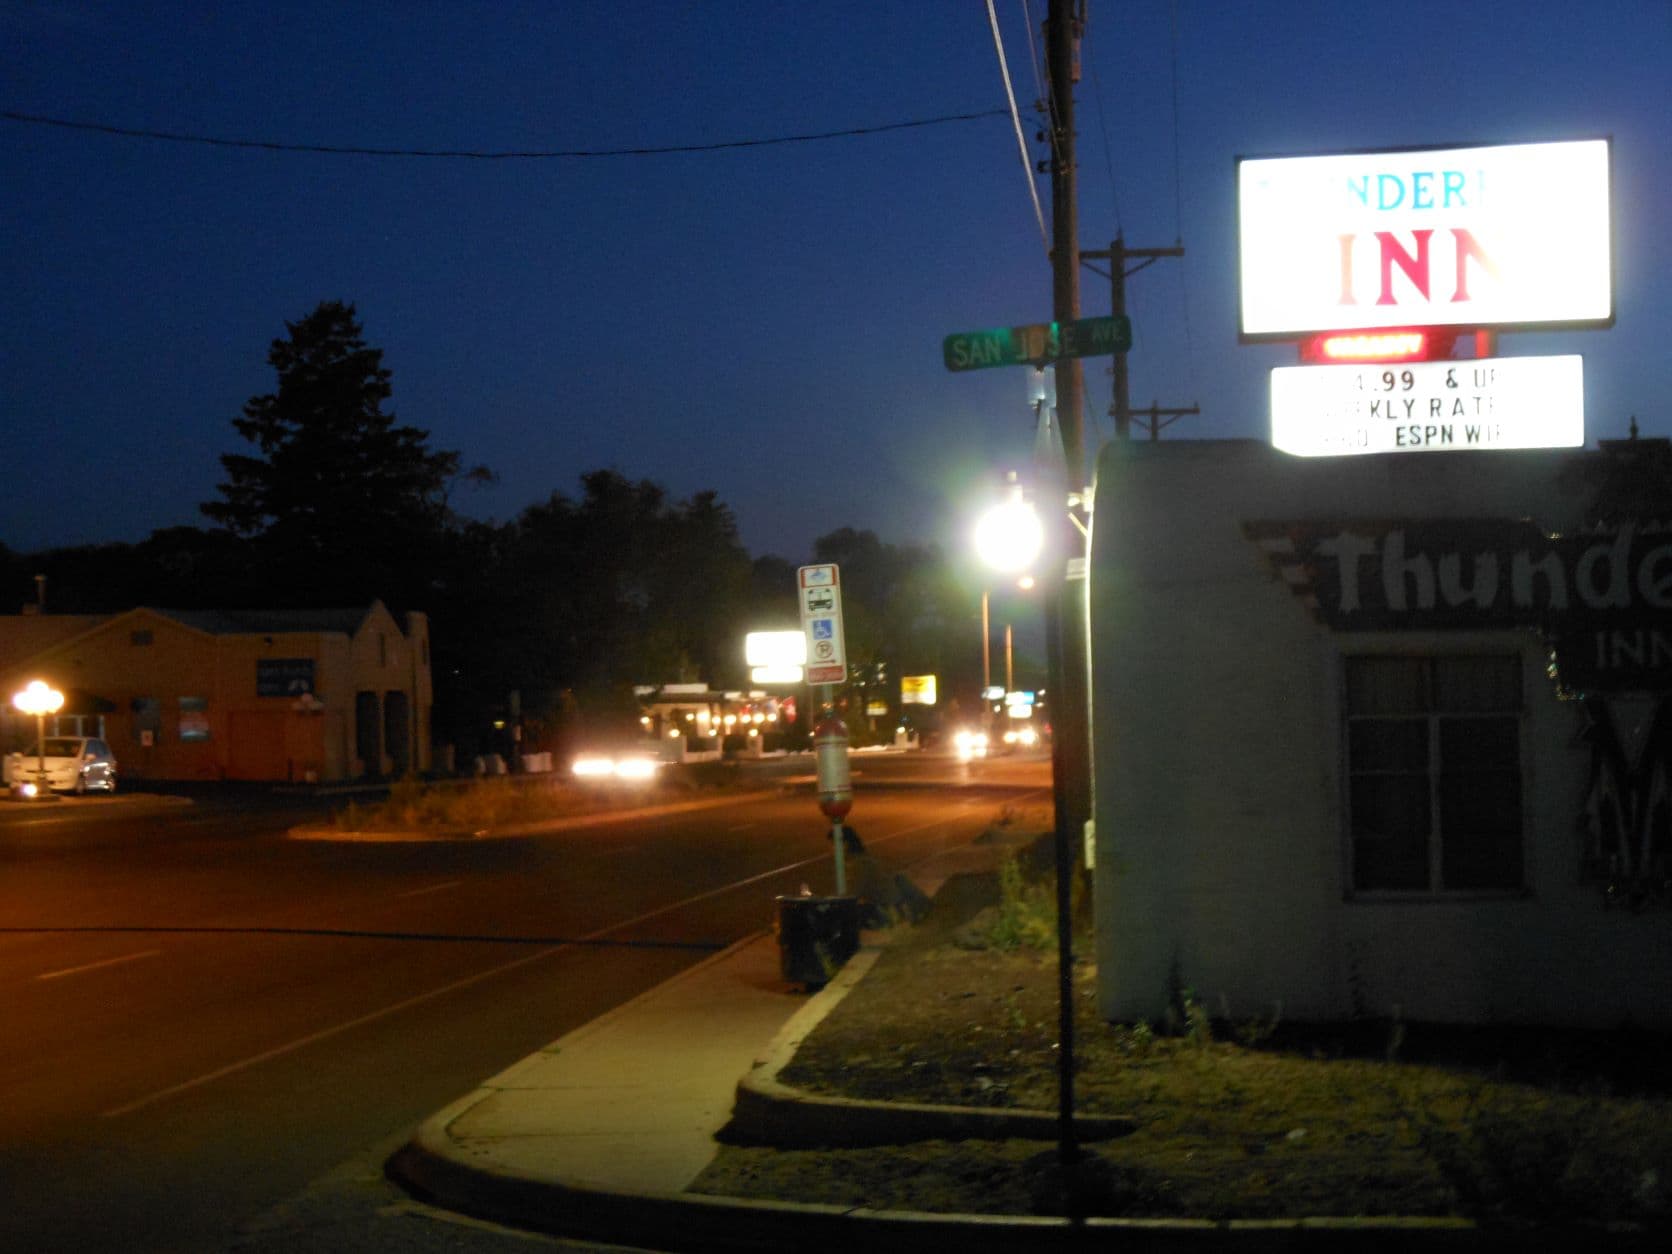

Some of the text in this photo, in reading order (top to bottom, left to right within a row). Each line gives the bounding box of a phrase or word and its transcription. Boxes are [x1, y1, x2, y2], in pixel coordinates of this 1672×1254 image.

[1337, 227, 1502, 306] INN
[952, 334, 1002, 367] SAN
[1015, 327, 1078, 361] JOSE
[1446, 368, 1459, 389] &
[1395, 424, 1453, 447] ESPN
